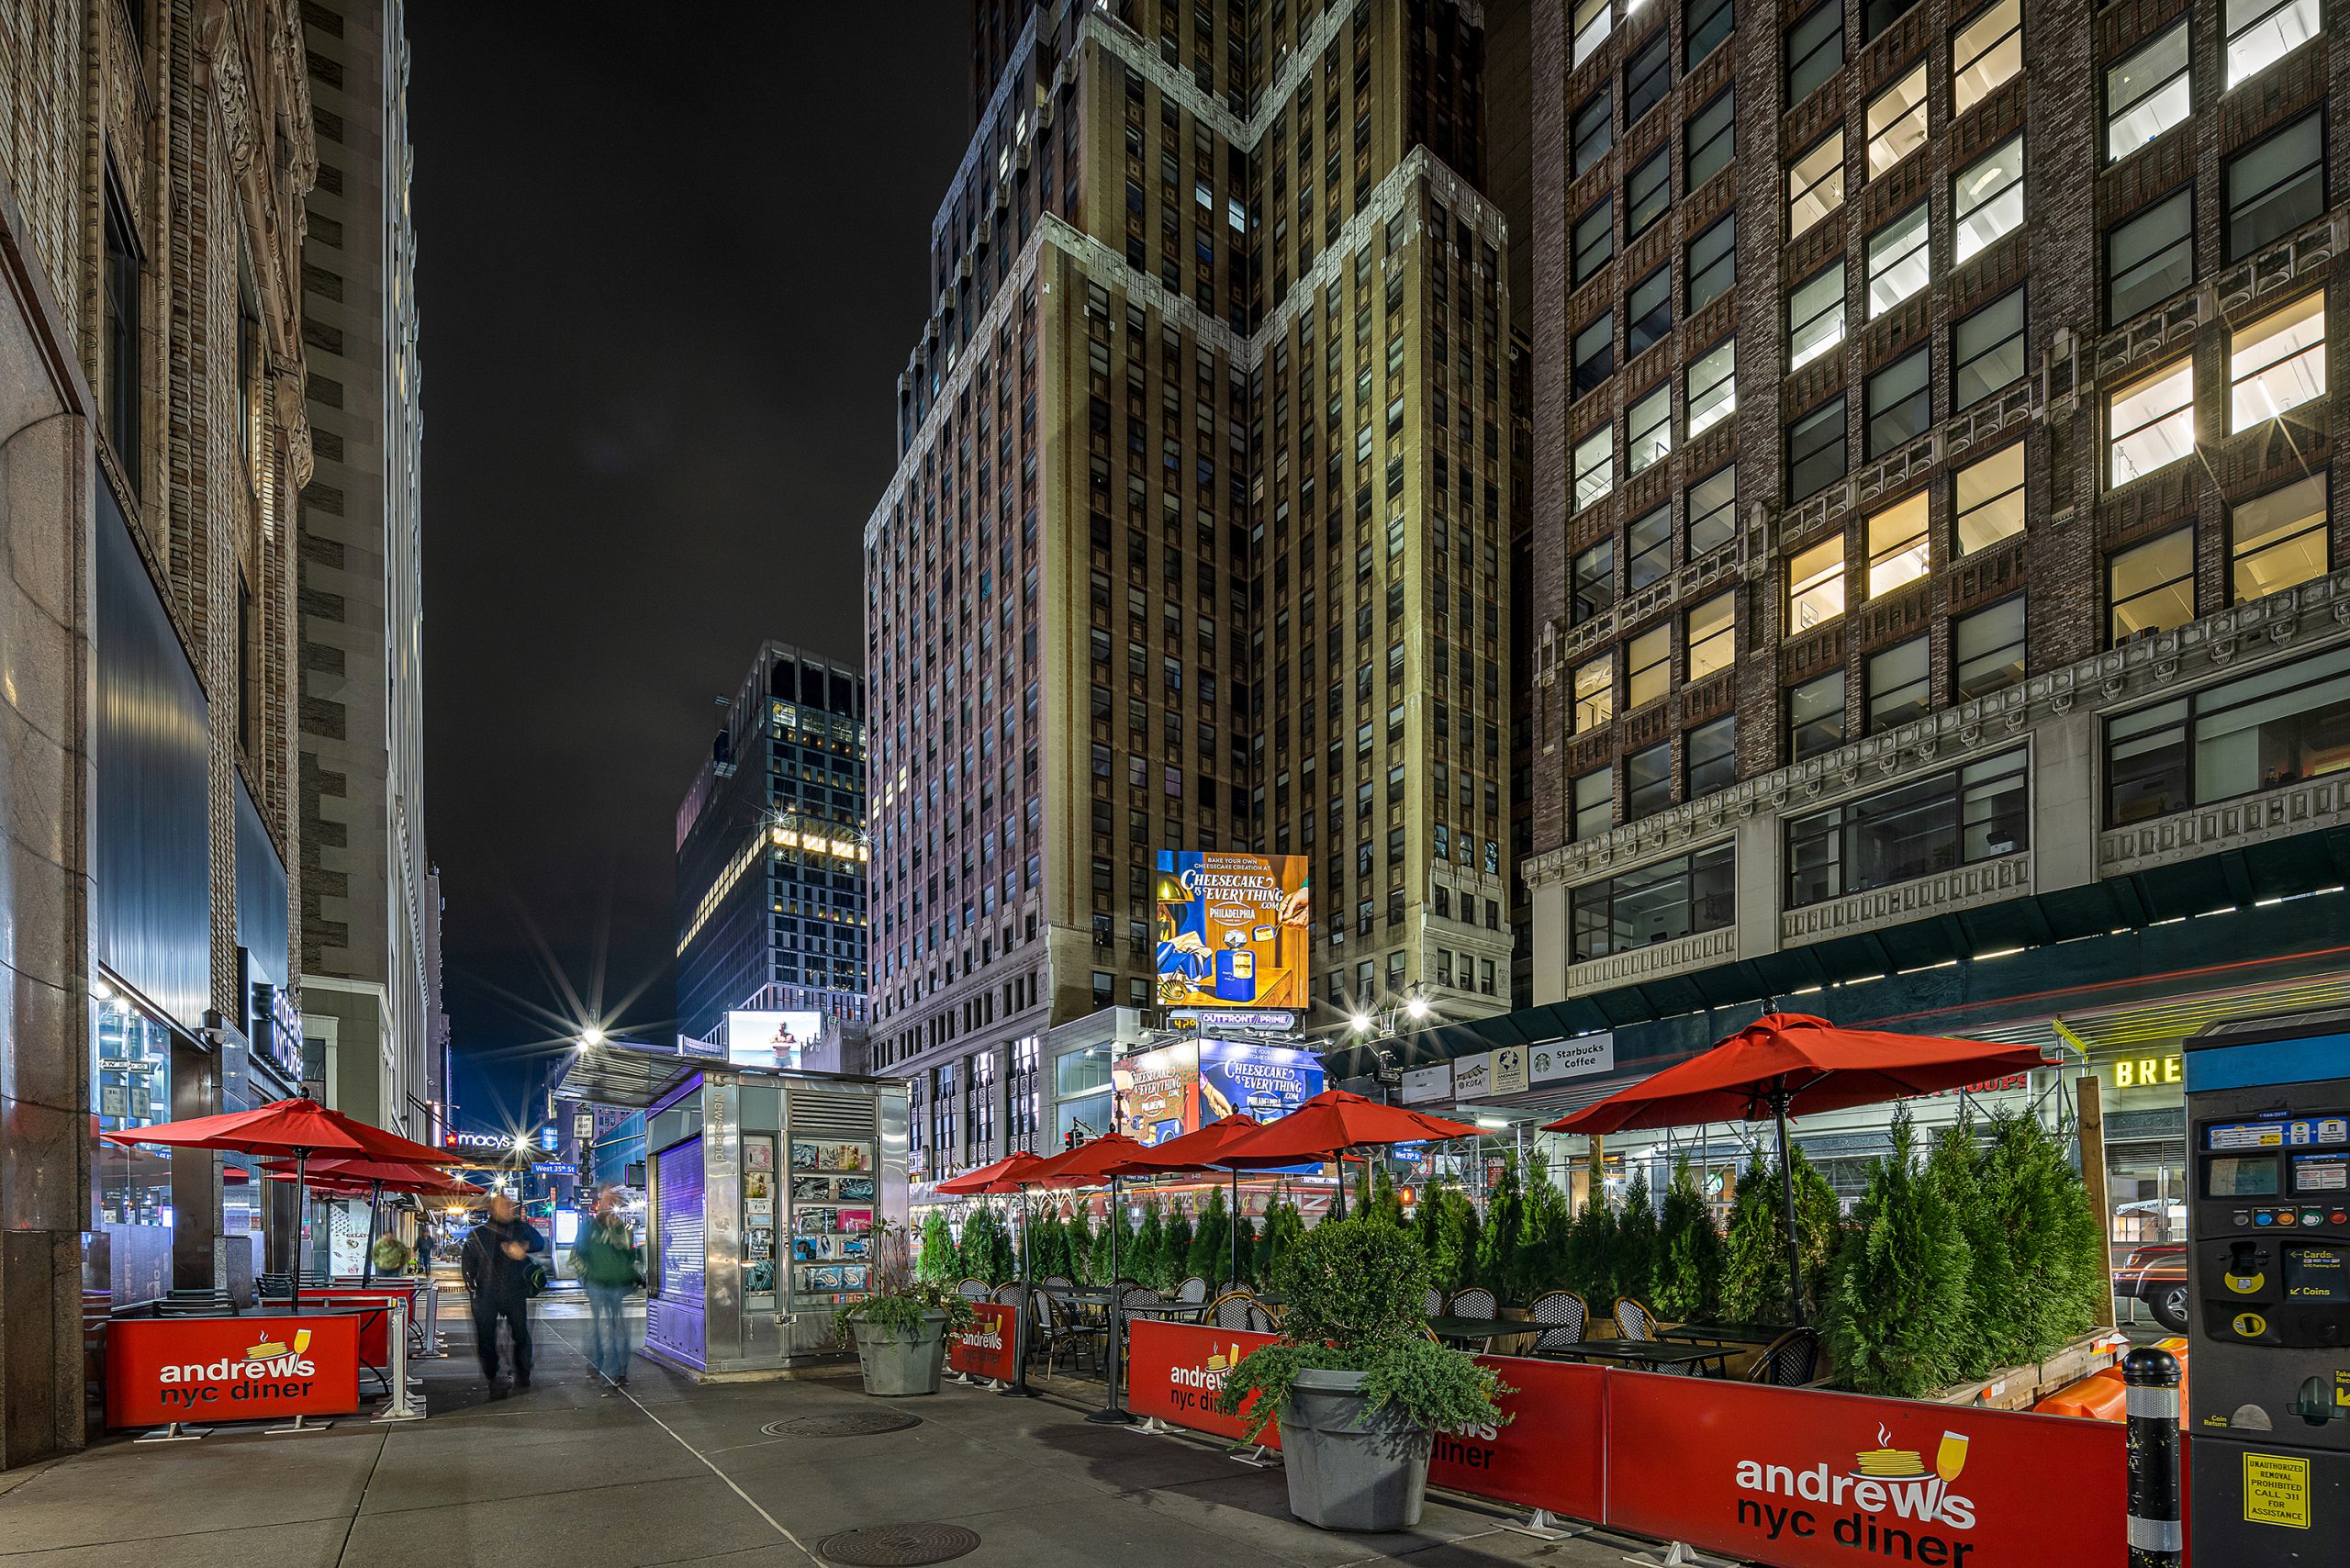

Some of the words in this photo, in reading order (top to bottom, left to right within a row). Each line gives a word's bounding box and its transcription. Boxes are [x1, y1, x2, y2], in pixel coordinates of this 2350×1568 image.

[1181, 869, 1274, 890] CHEESECAKE
[1194, 886, 1202, 896] IS
[1203, 887, 1284, 904] EVERYTHING
[1209, 907, 1256, 919] PHILADELPHIA
[1202, 1014, 1256, 1024] OUTFRONT
[1259, 1014, 1288, 1023] PRIME
[1556, 1044, 1605, 1058] Starbucks
[1225, 1058, 1295, 1081] CHEESECAKE
[1564, 1057, 1596, 1069] Coffee
[2117, 1056, 2181, 1087] BRE
[1138, 1074, 1181, 1096] EVERYTHING
[1241, 1076, 1303, 1093] EVERYTHING
[713, 1092, 727, 1162] Newsstand
[459, 1134, 510, 1149] macy's
[962, 1330, 1002, 1350] andrews
[160, 1354, 316, 1383] andrews
[161, 1385, 219, 1409] nyc
[230, 1380, 314, 1402] diner
[1170, 1389, 1196, 1411] nyc
[2204, 1419, 2227, 1428] Return
[2249, 1461, 2303, 1473] UNAUTHORIZED
[2260, 1471, 2292, 1481] REMOVAL
[2251, 1479, 2302, 1492] PROHIBITED
[1736, 1460, 1975, 1529] andrews
[2255, 1489, 2281, 1498] CALL
[2285, 1493, 2300, 1501] 311
[2268, 1500, 2285, 1508] FOR
[2252, 1507, 2303, 1520] ASSISTANCE
[1738, 1498, 1816, 1540] nyc
[1833, 1513, 1974, 1568] diner
